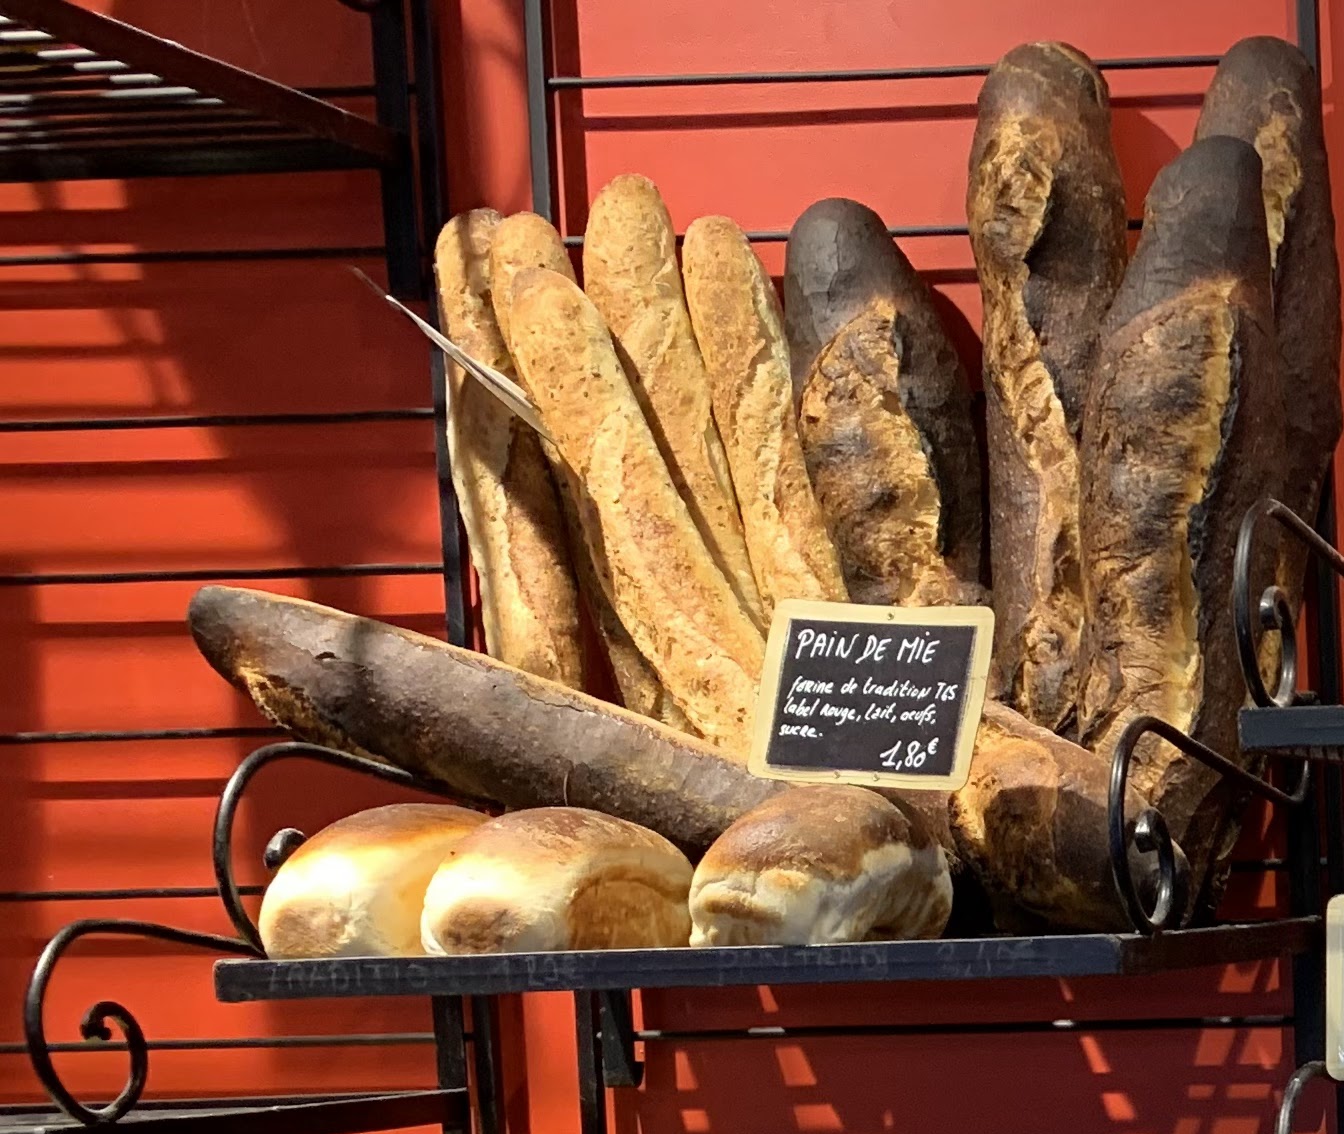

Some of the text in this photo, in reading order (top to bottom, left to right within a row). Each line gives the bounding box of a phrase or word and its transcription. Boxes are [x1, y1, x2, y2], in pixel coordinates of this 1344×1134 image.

[795, 629, 940, 664] PAIN DE MIE
[787, 675, 958, 701] farine de tradition T65
[783, 697, 821, 715] label
